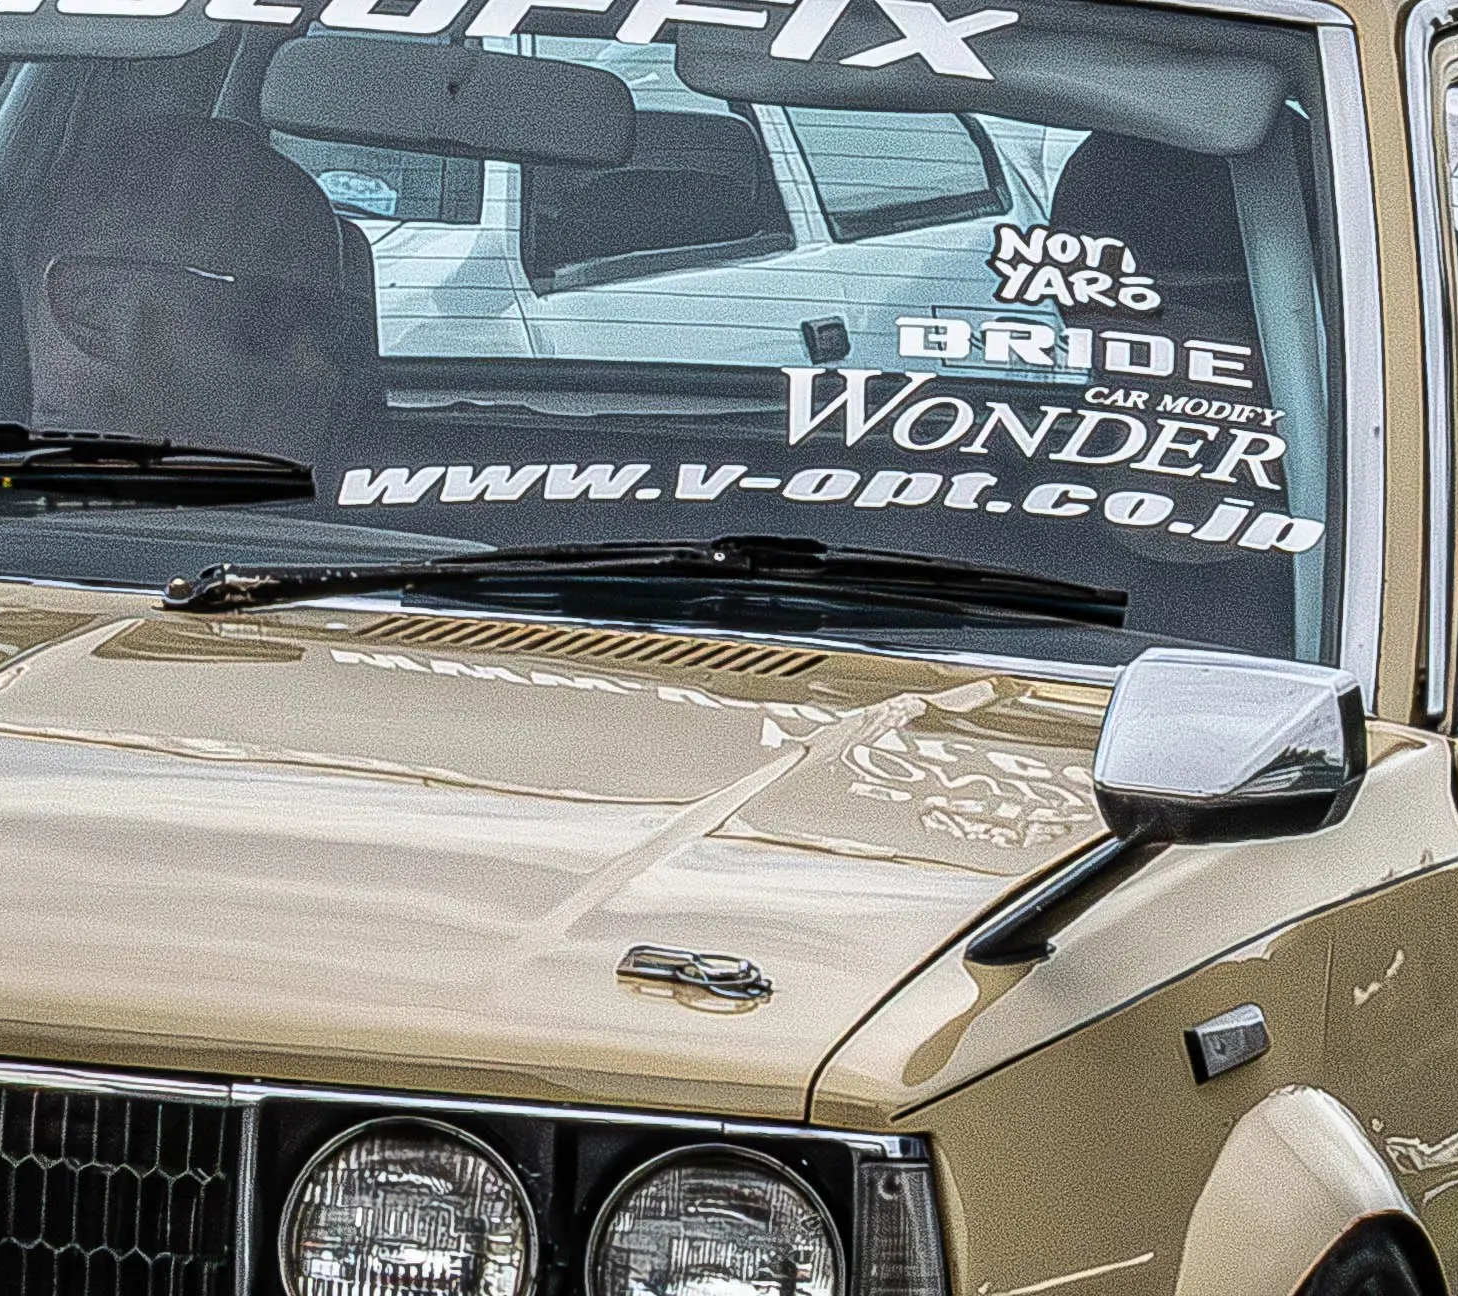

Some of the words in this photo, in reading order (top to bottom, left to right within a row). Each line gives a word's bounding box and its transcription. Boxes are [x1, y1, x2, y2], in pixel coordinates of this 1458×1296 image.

[895, 316, 1256, 390] BRIDE
[781, 367, 1287, 491] WONDER
[1084, 386, 1147, 409] CAR
[1159, 393, 1288, 425] MODIFY
[337, 461, 1327, 554] www.v-opt.co.jp
